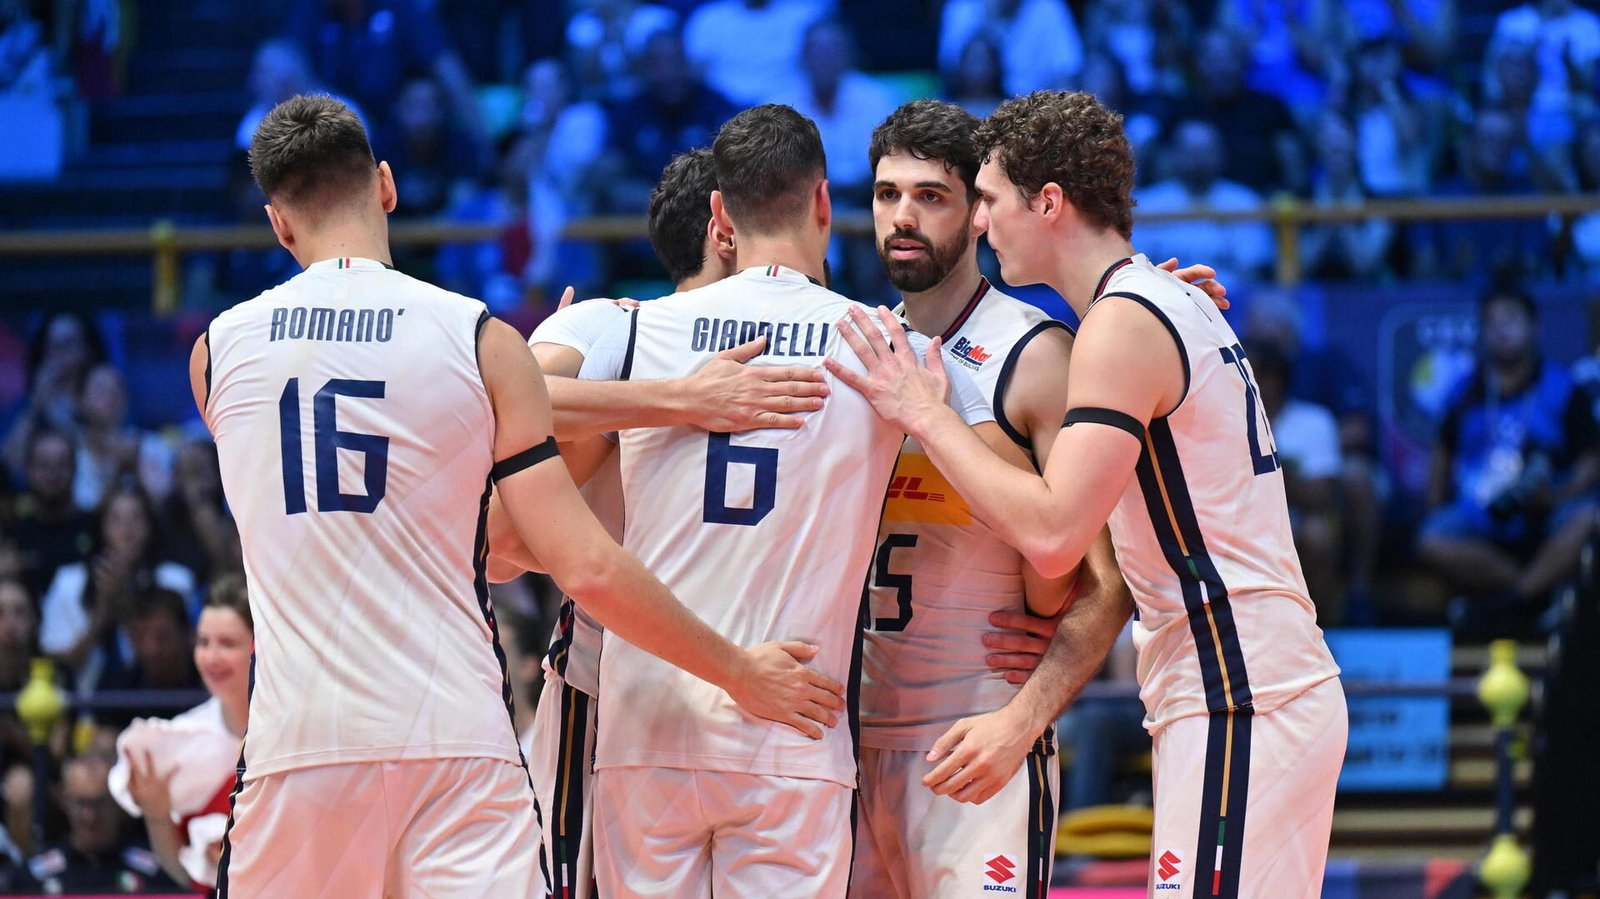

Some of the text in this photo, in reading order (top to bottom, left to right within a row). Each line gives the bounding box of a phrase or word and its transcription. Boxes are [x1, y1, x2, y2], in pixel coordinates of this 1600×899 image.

[279, 377, 390, 515] 16
[703, 431, 779, 526] 6
[983, 884, 1017, 893] SUZUKI
